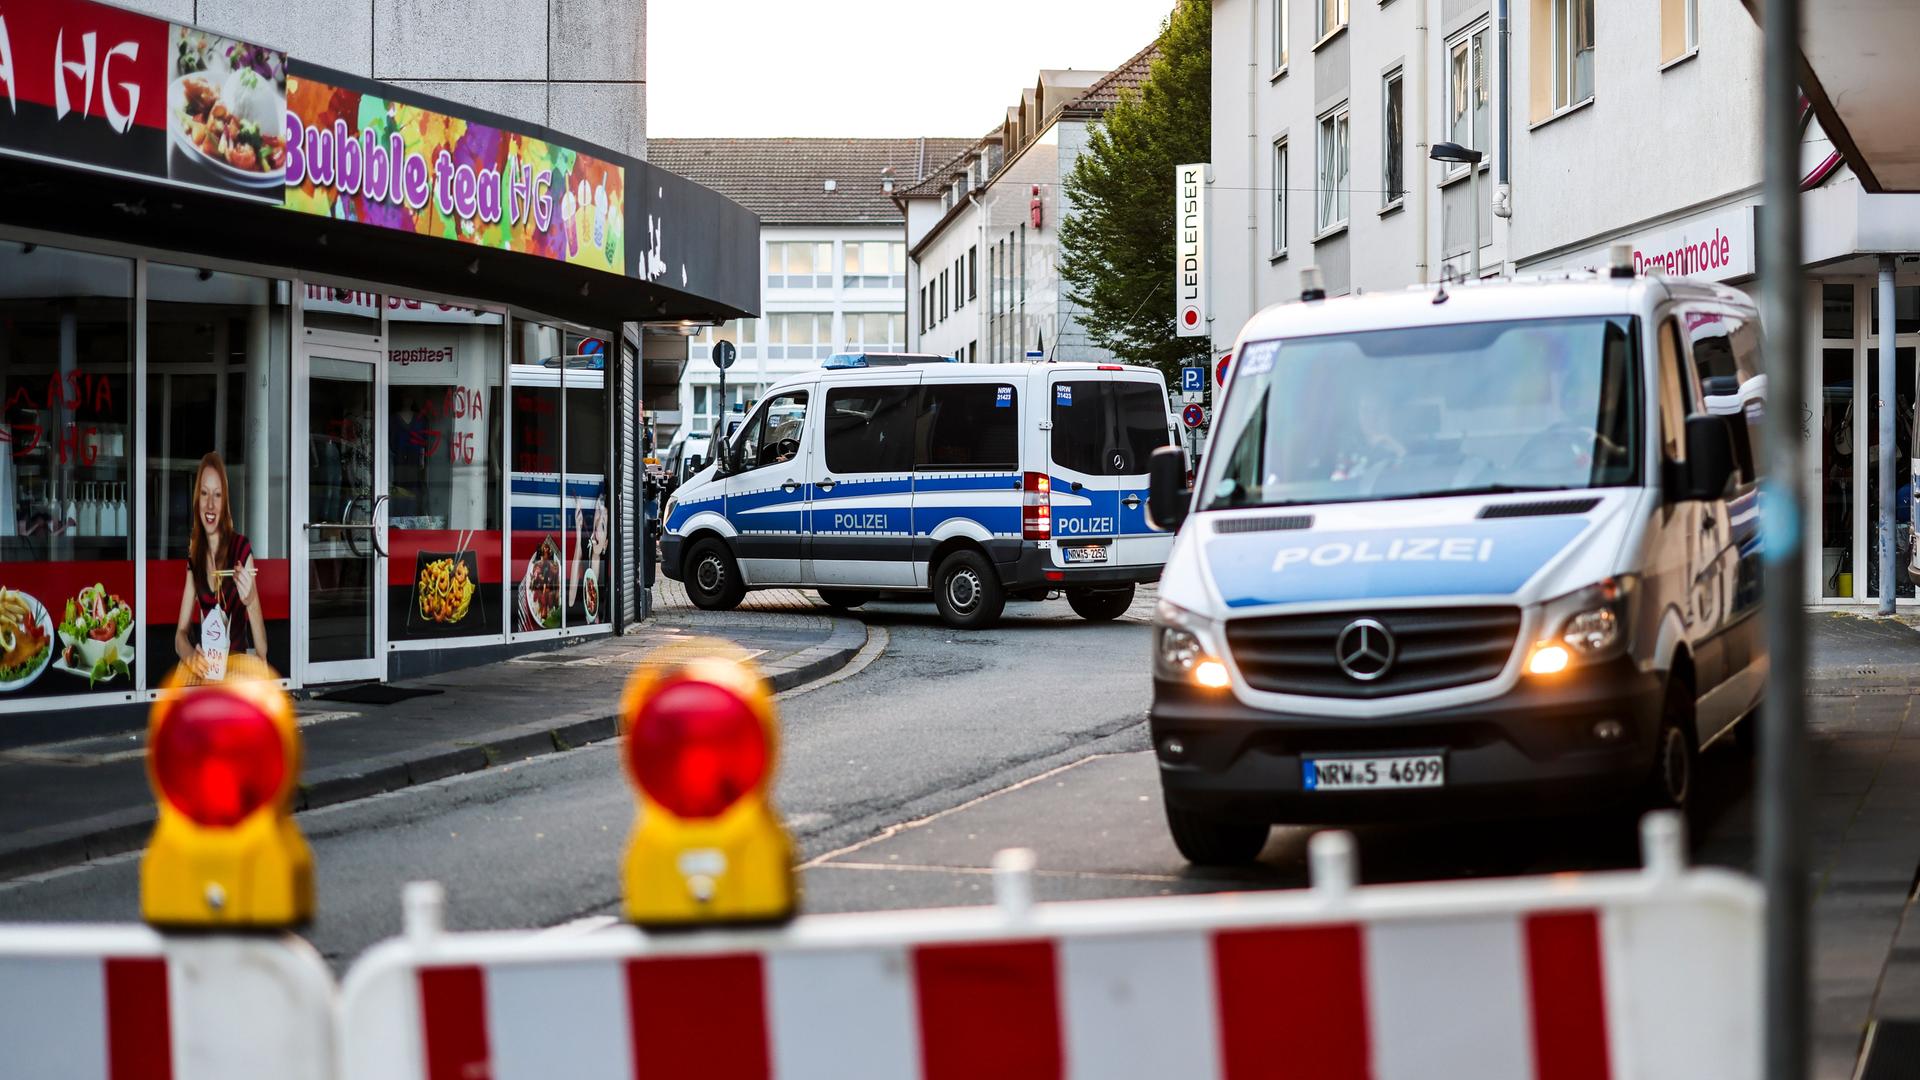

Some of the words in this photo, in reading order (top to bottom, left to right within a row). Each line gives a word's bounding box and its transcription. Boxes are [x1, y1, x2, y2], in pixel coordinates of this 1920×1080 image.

[54, 26, 140, 134] HG
[285, 109, 430, 209] Bubble
[436, 150, 502, 222] tea
[509, 154, 554, 233] HG
[1184, 169, 1198, 300] LEDLENSER
[46, 367, 114, 416] ASIA
[443, 384, 483, 421] ASIA
[1056, 385, 1072, 393] NRW
[59, 422, 98, 467] HG
[449, 431, 475, 465] HG
[834, 513, 888, 529] POLIZEI
[1058, 516, 1113, 534] POLIZEI
[1272, 537, 1494, 572] POLIZEI
